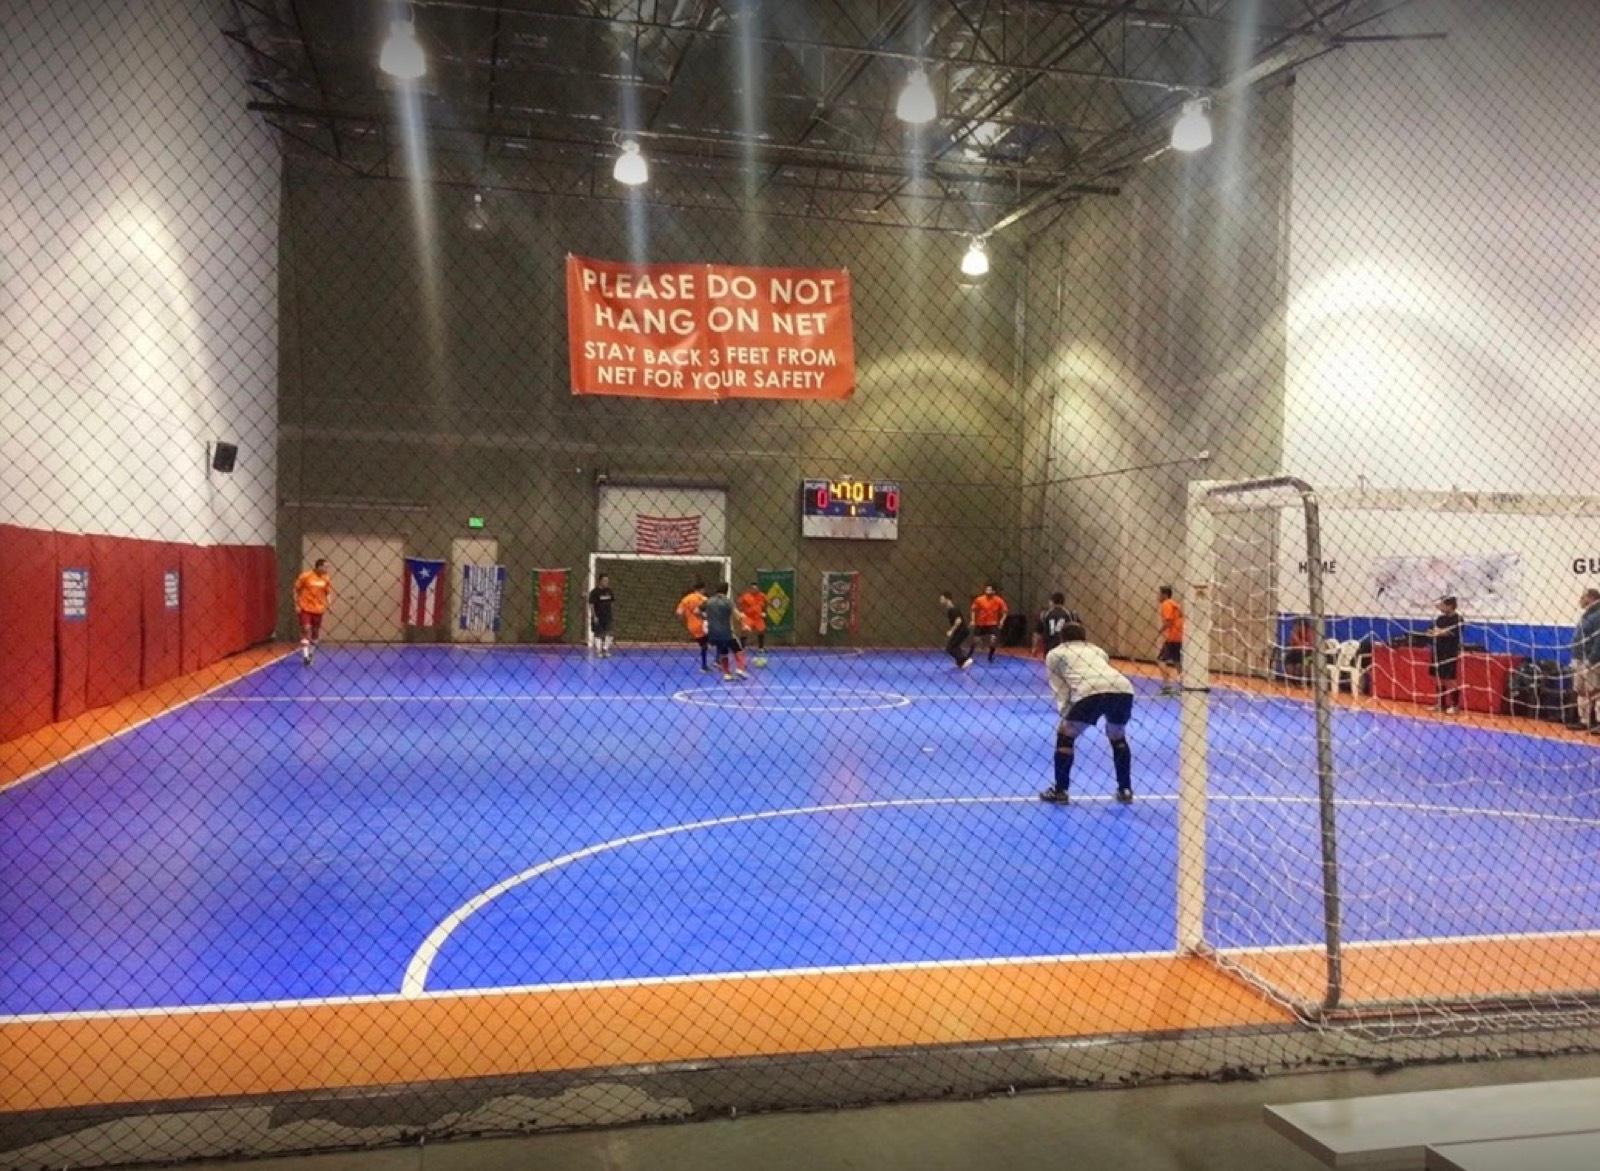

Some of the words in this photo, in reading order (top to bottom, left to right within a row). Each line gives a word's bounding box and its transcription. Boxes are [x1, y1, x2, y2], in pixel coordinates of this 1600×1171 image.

[582, 268, 696, 300] PLEASE
[707, 274, 757, 300] DO
[770, 278, 836, 305] NOT
[595, 302, 696, 336] HANG
[707, 306, 760, 333] ON
[772, 312, 828, 336] NET
[584, 340, 636, 362] STAY
[643, 348, 703, 367] BACK
[709, 349, 720, 367] 3
[727, 346, 770, 366] FEET
[777, 348, 837, 367] FROM
[598, 366, 637, 385] NET
[643, 370, 683, 388] FOR
[691, 370, 747, 391] YOUR
[753, 371, 826, 390] SAFETY
[1298, 561, 1337, 575] HME
